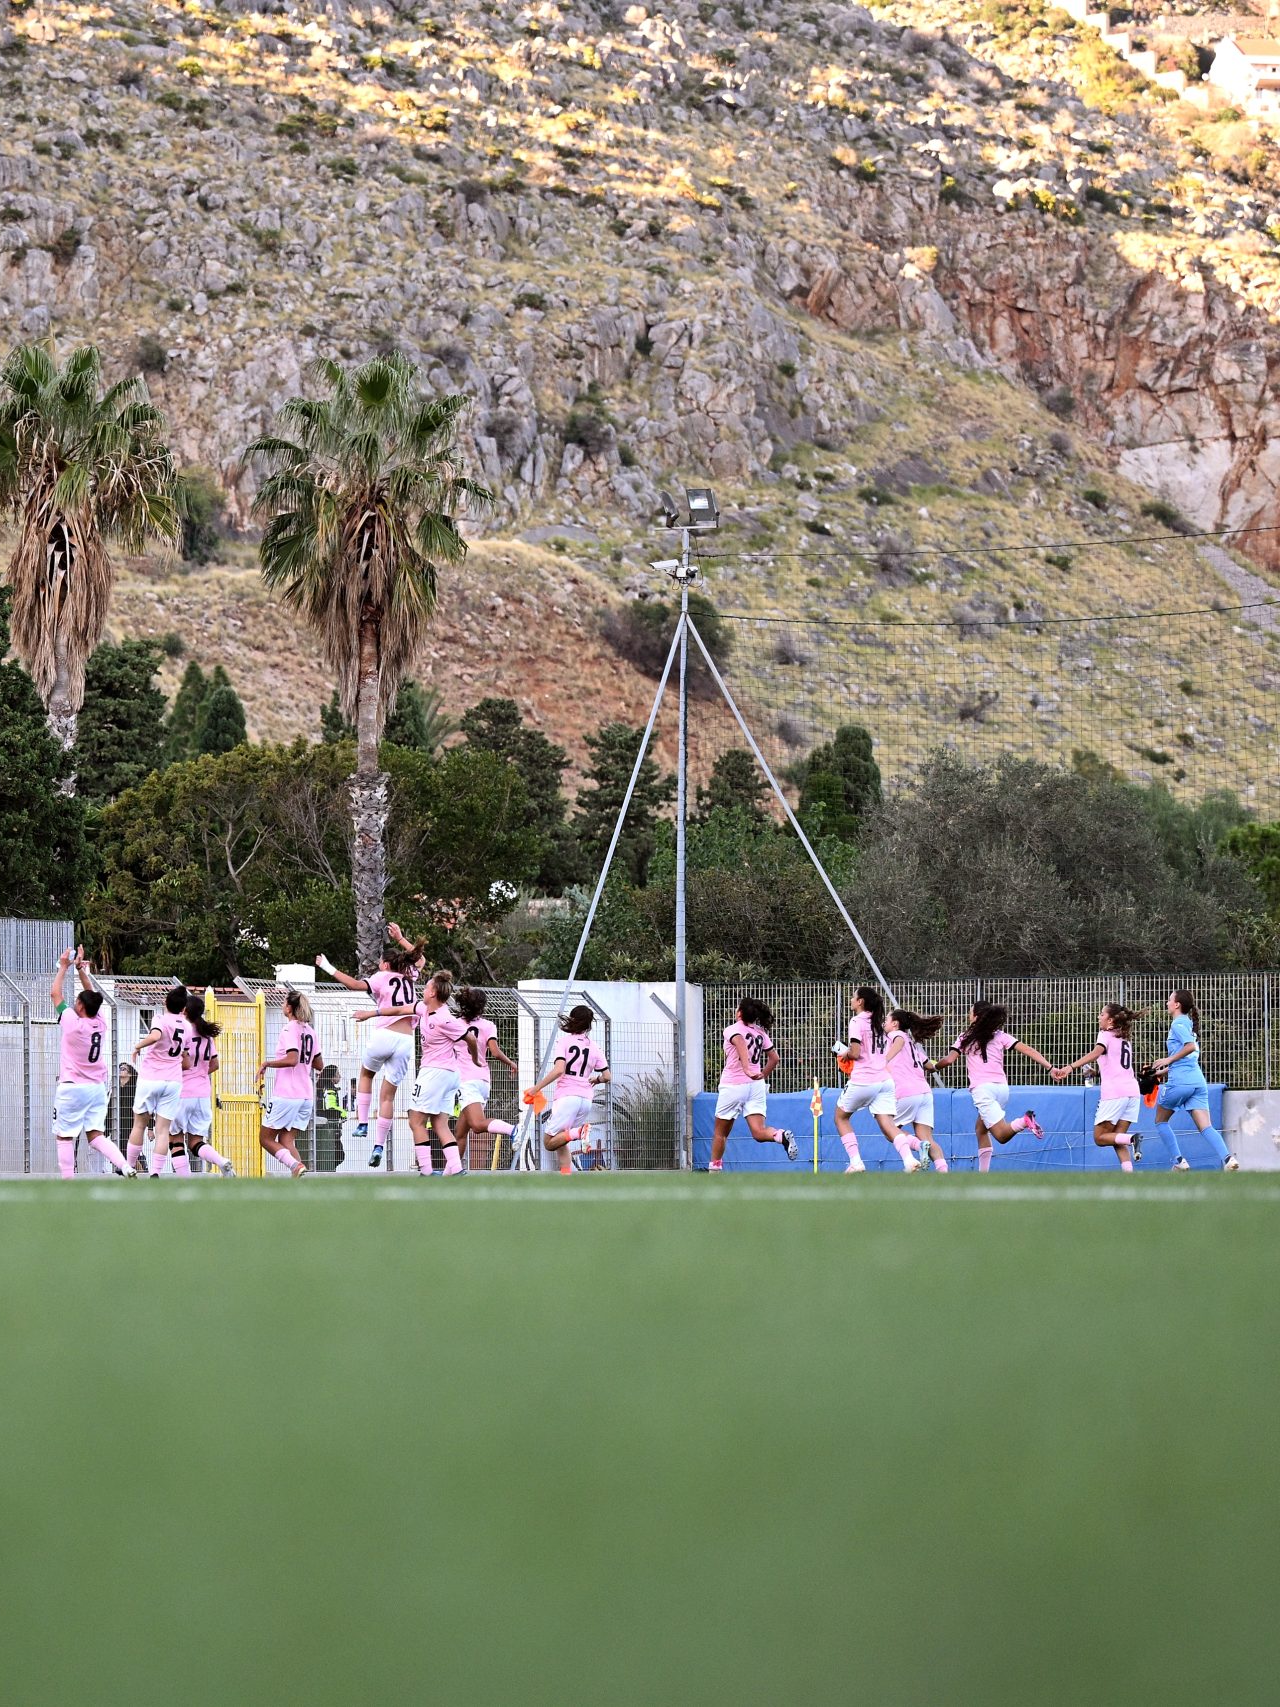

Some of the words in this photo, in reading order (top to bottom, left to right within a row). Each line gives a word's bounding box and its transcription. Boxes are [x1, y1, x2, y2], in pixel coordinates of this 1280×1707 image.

[389, 976, 414, 1007] 20
[88, 1031, 102, 1063] 8
[168, 1028, 184, 1057] 5
[300, 1032, 314, 1065] 19
[1120, 1040, 1131, 1070] 6
[565, 1045, 590, 1077] 21
